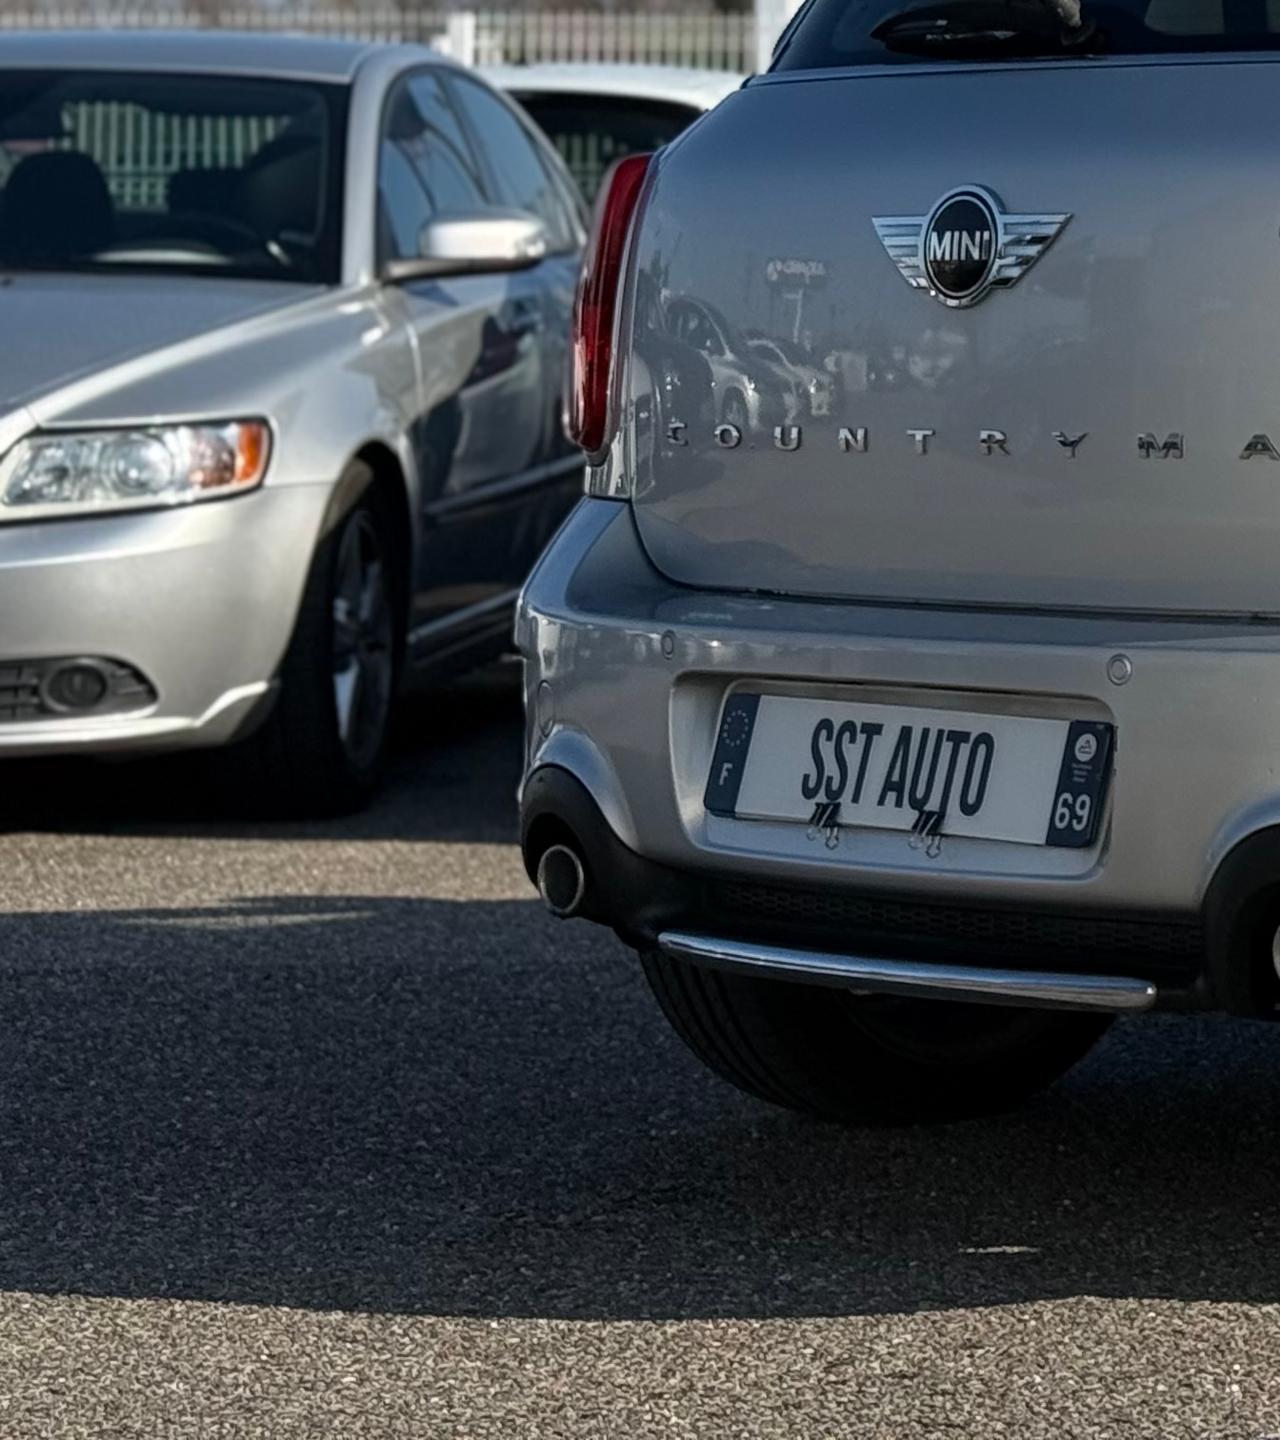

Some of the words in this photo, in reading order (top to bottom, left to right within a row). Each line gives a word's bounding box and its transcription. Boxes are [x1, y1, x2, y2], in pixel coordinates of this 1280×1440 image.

[929, 230, 990, 262] MINI
[717, 762, 734, 787] F
[801, 717, 884, 805] SST
[876, 724, 996, 818] AUTO
[1054, 791, 1092, 832] 69
